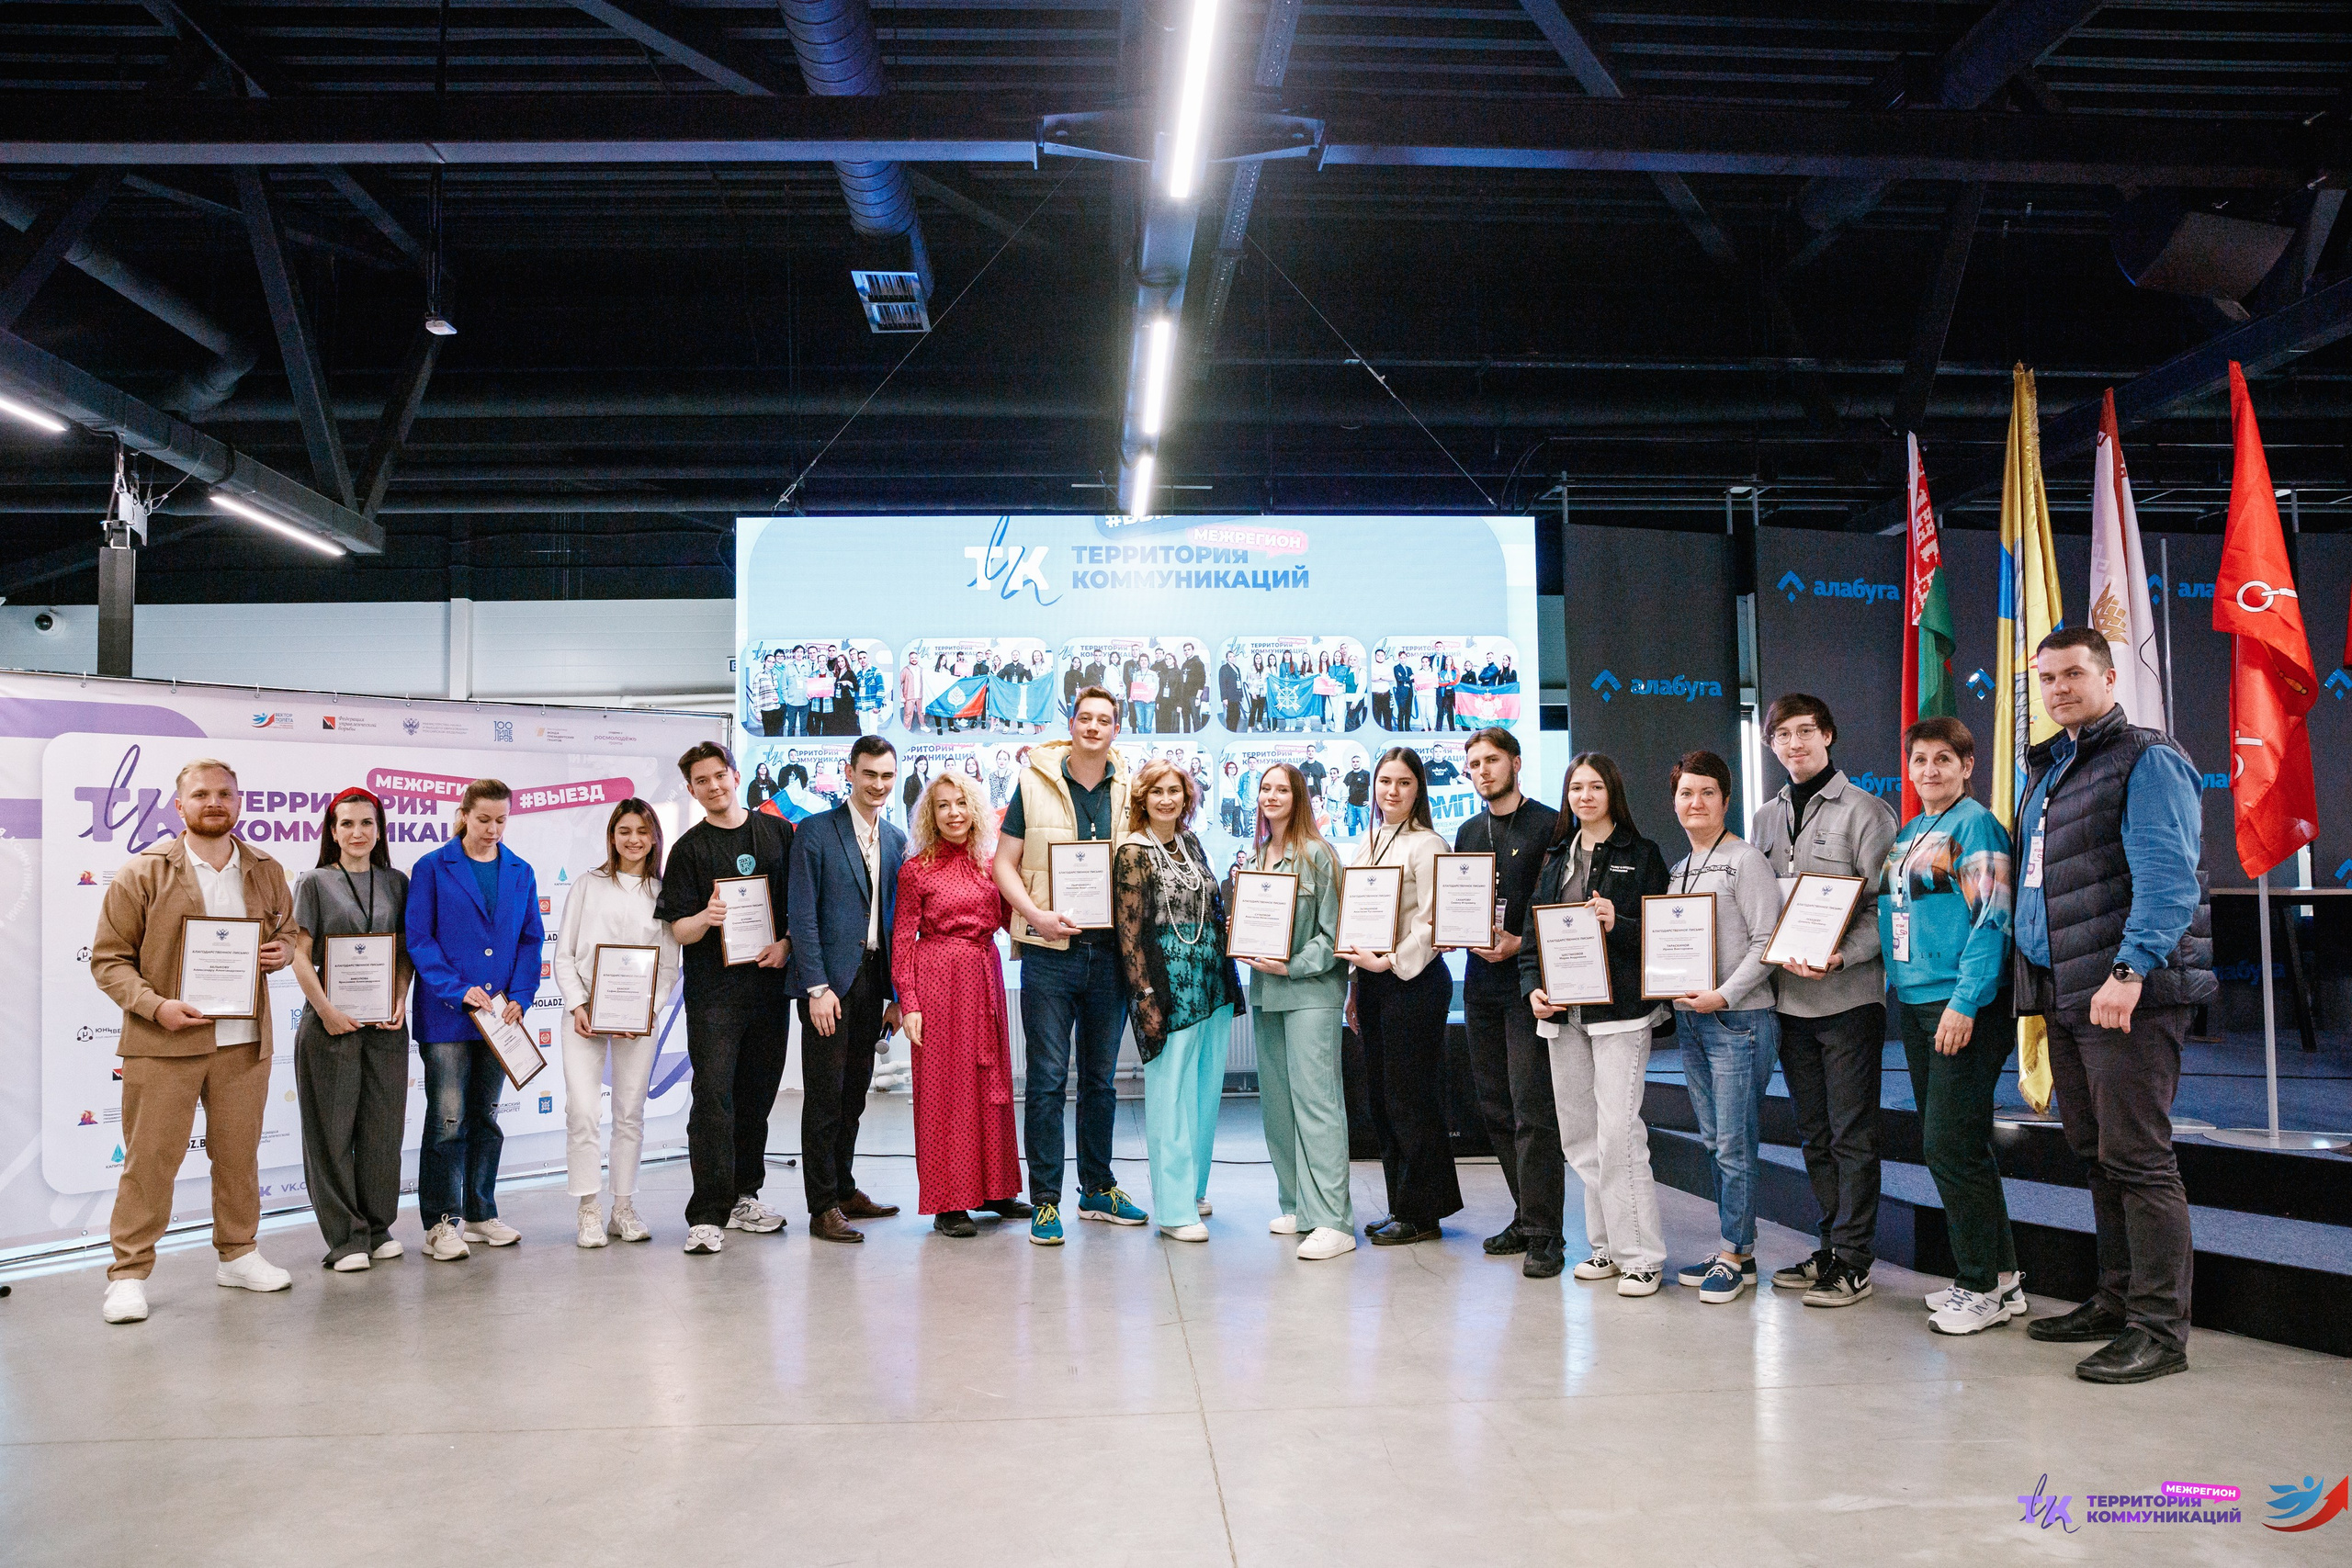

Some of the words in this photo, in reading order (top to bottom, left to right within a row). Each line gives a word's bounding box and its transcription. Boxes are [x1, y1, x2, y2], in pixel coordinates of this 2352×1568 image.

[1193, 527, 1302, 549] МЕЖРЕГИОН
[1071, 545, 1249, 564] ТЕРРИТОРИЯ
[1071, 565, 1310, 592] КОММУНИКАЦИЙ
[1813, 577, 1901, 604] алабуга
[1630, 674, 1723, 703] алабуга
[493, 720, 514, 729] 100
[375, 774, 468, 796] МЕЖРЕГИ
[519, 784, 605, 809] #ВЫЕЗД
